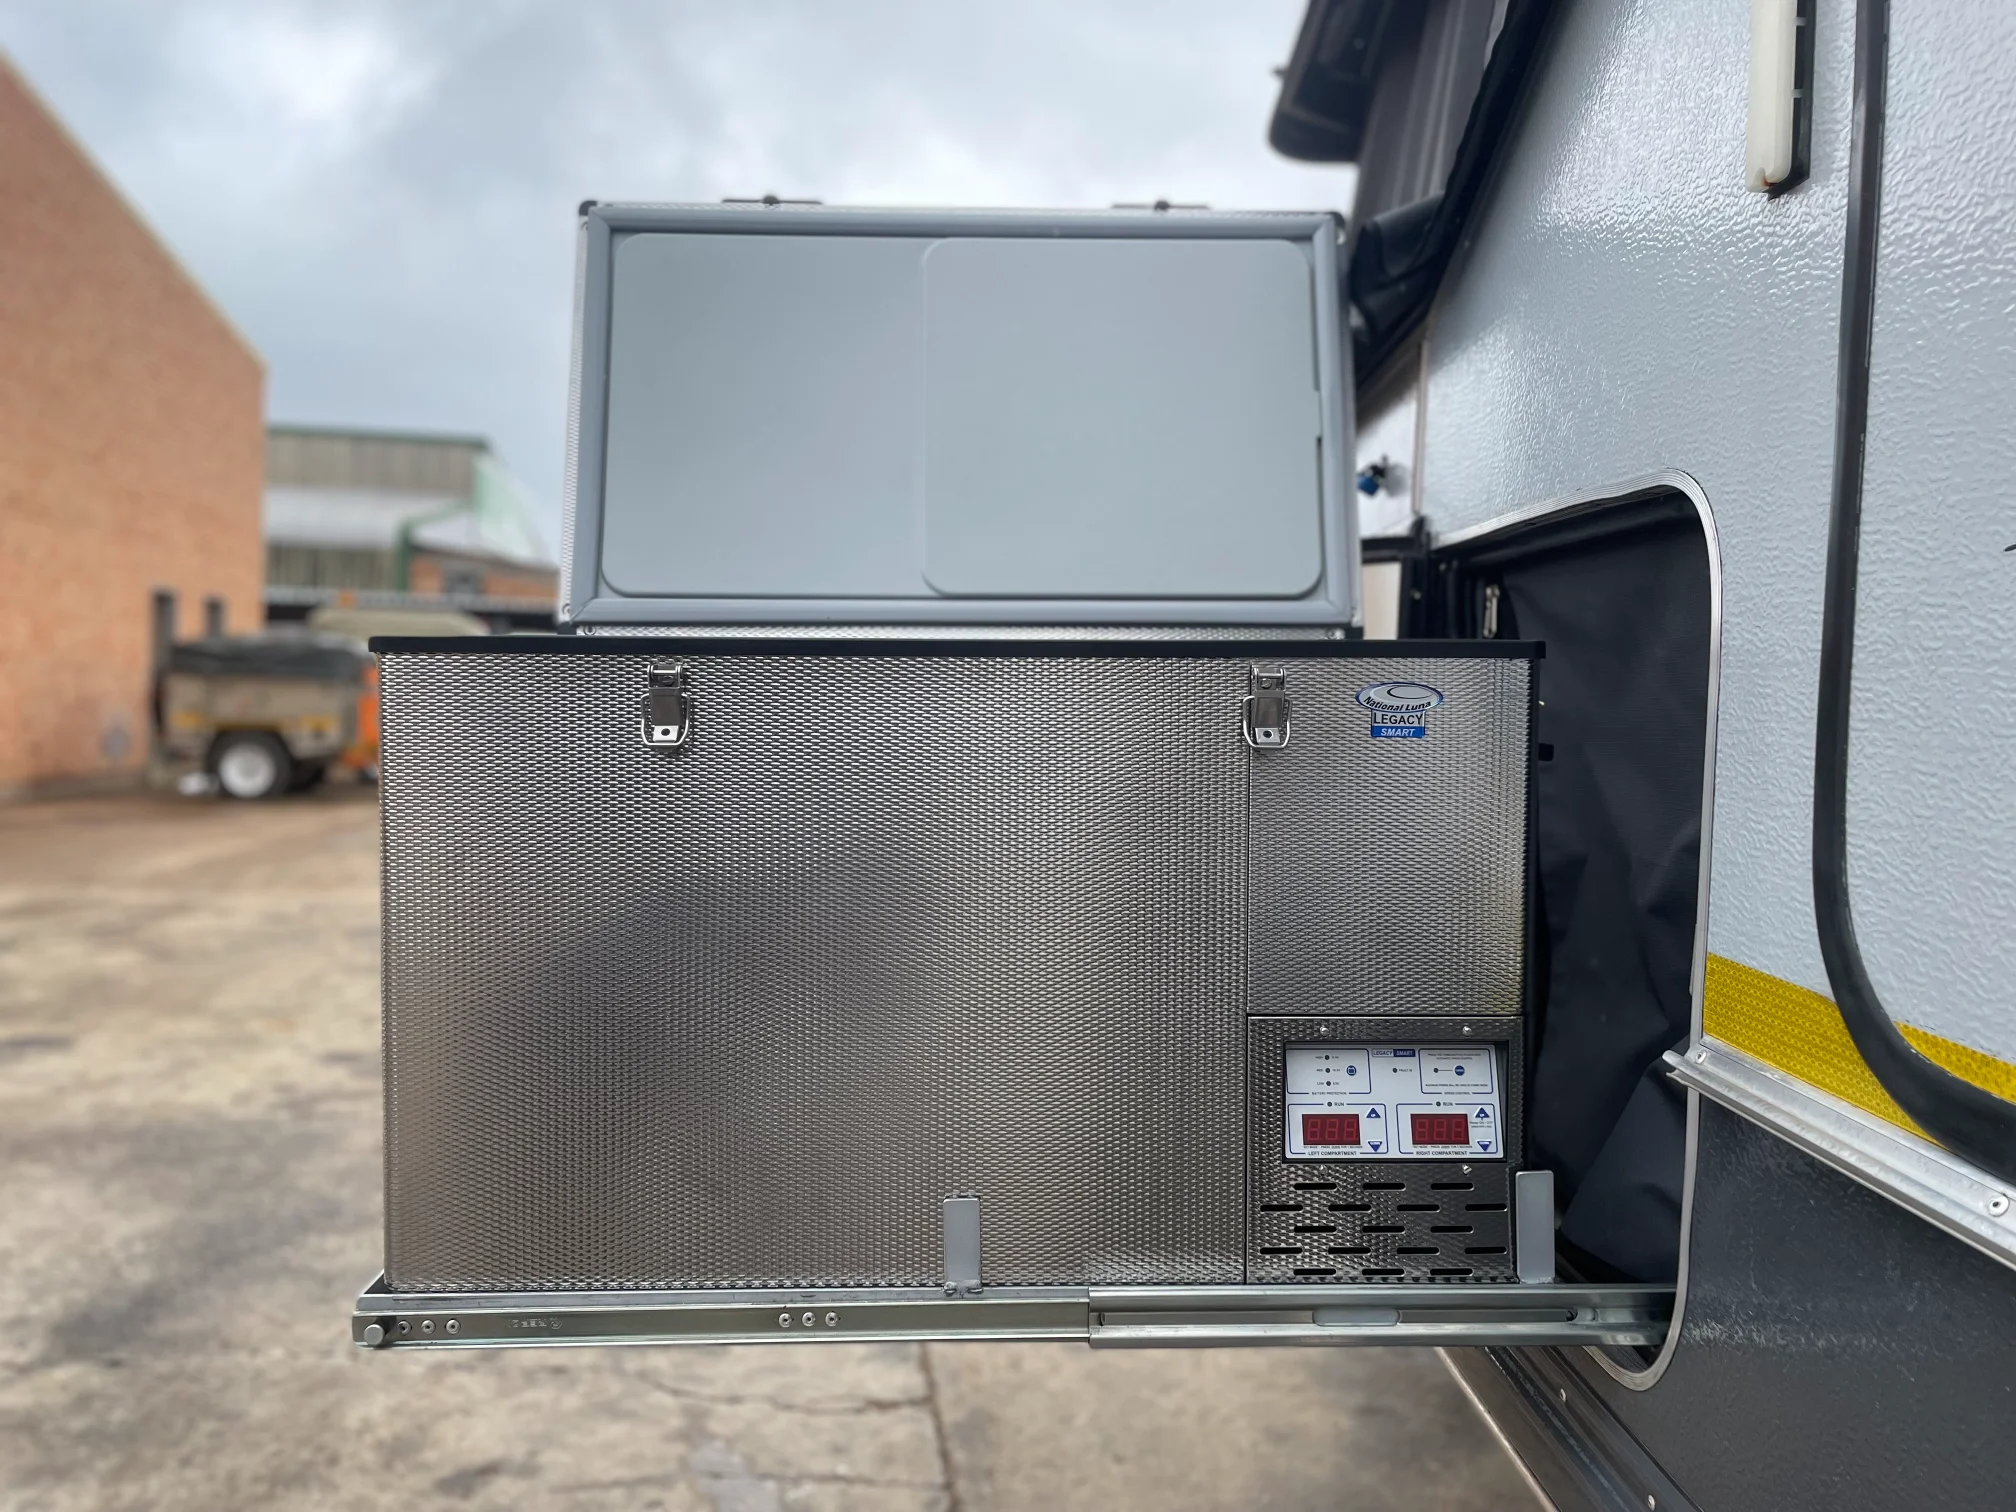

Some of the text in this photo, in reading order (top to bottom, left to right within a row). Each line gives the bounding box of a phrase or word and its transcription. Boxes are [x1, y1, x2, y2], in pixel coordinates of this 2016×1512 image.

[1363, 696, 1432, 711] National Luna
[1373, 712, 1423, 725] LEGACY
[1380, 728, 1416, 736] SMART
